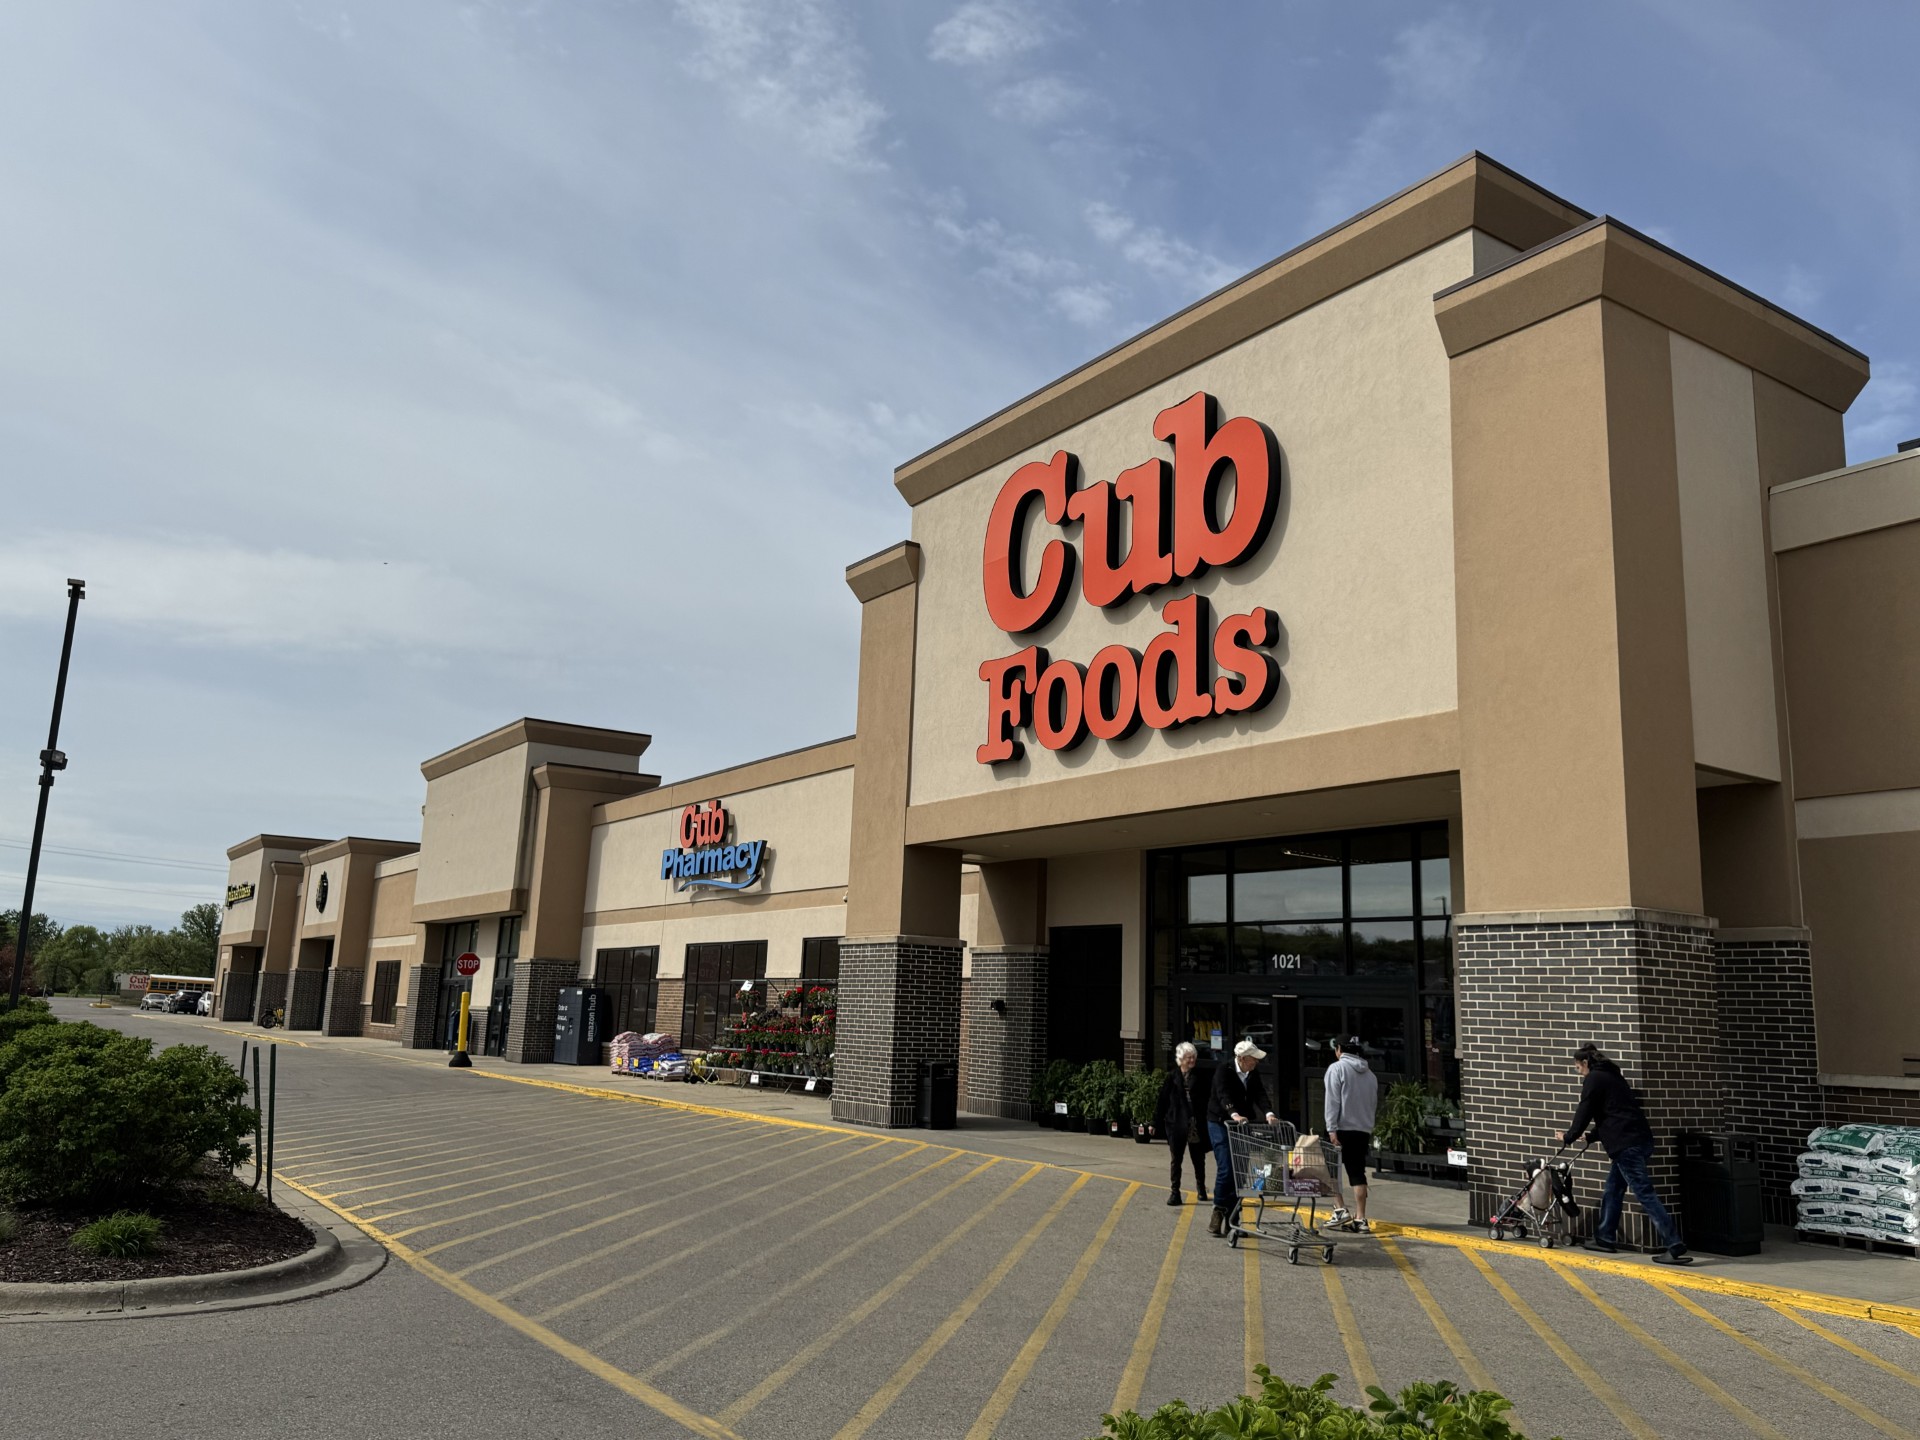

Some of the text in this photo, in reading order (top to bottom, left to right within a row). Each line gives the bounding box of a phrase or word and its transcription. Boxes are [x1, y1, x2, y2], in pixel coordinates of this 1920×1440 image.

[983, 390, 1281, 634] Cub
[977, 593, 1280, 765] Foods
[680, 800, 728, 848] Cub
[661, 840, 767, 880] Pharmacy
[457, 960, 479, 969] STOP
[1272, 954, 1300, 969] 1021
[587, 994, 597, 1042] amazon hub
